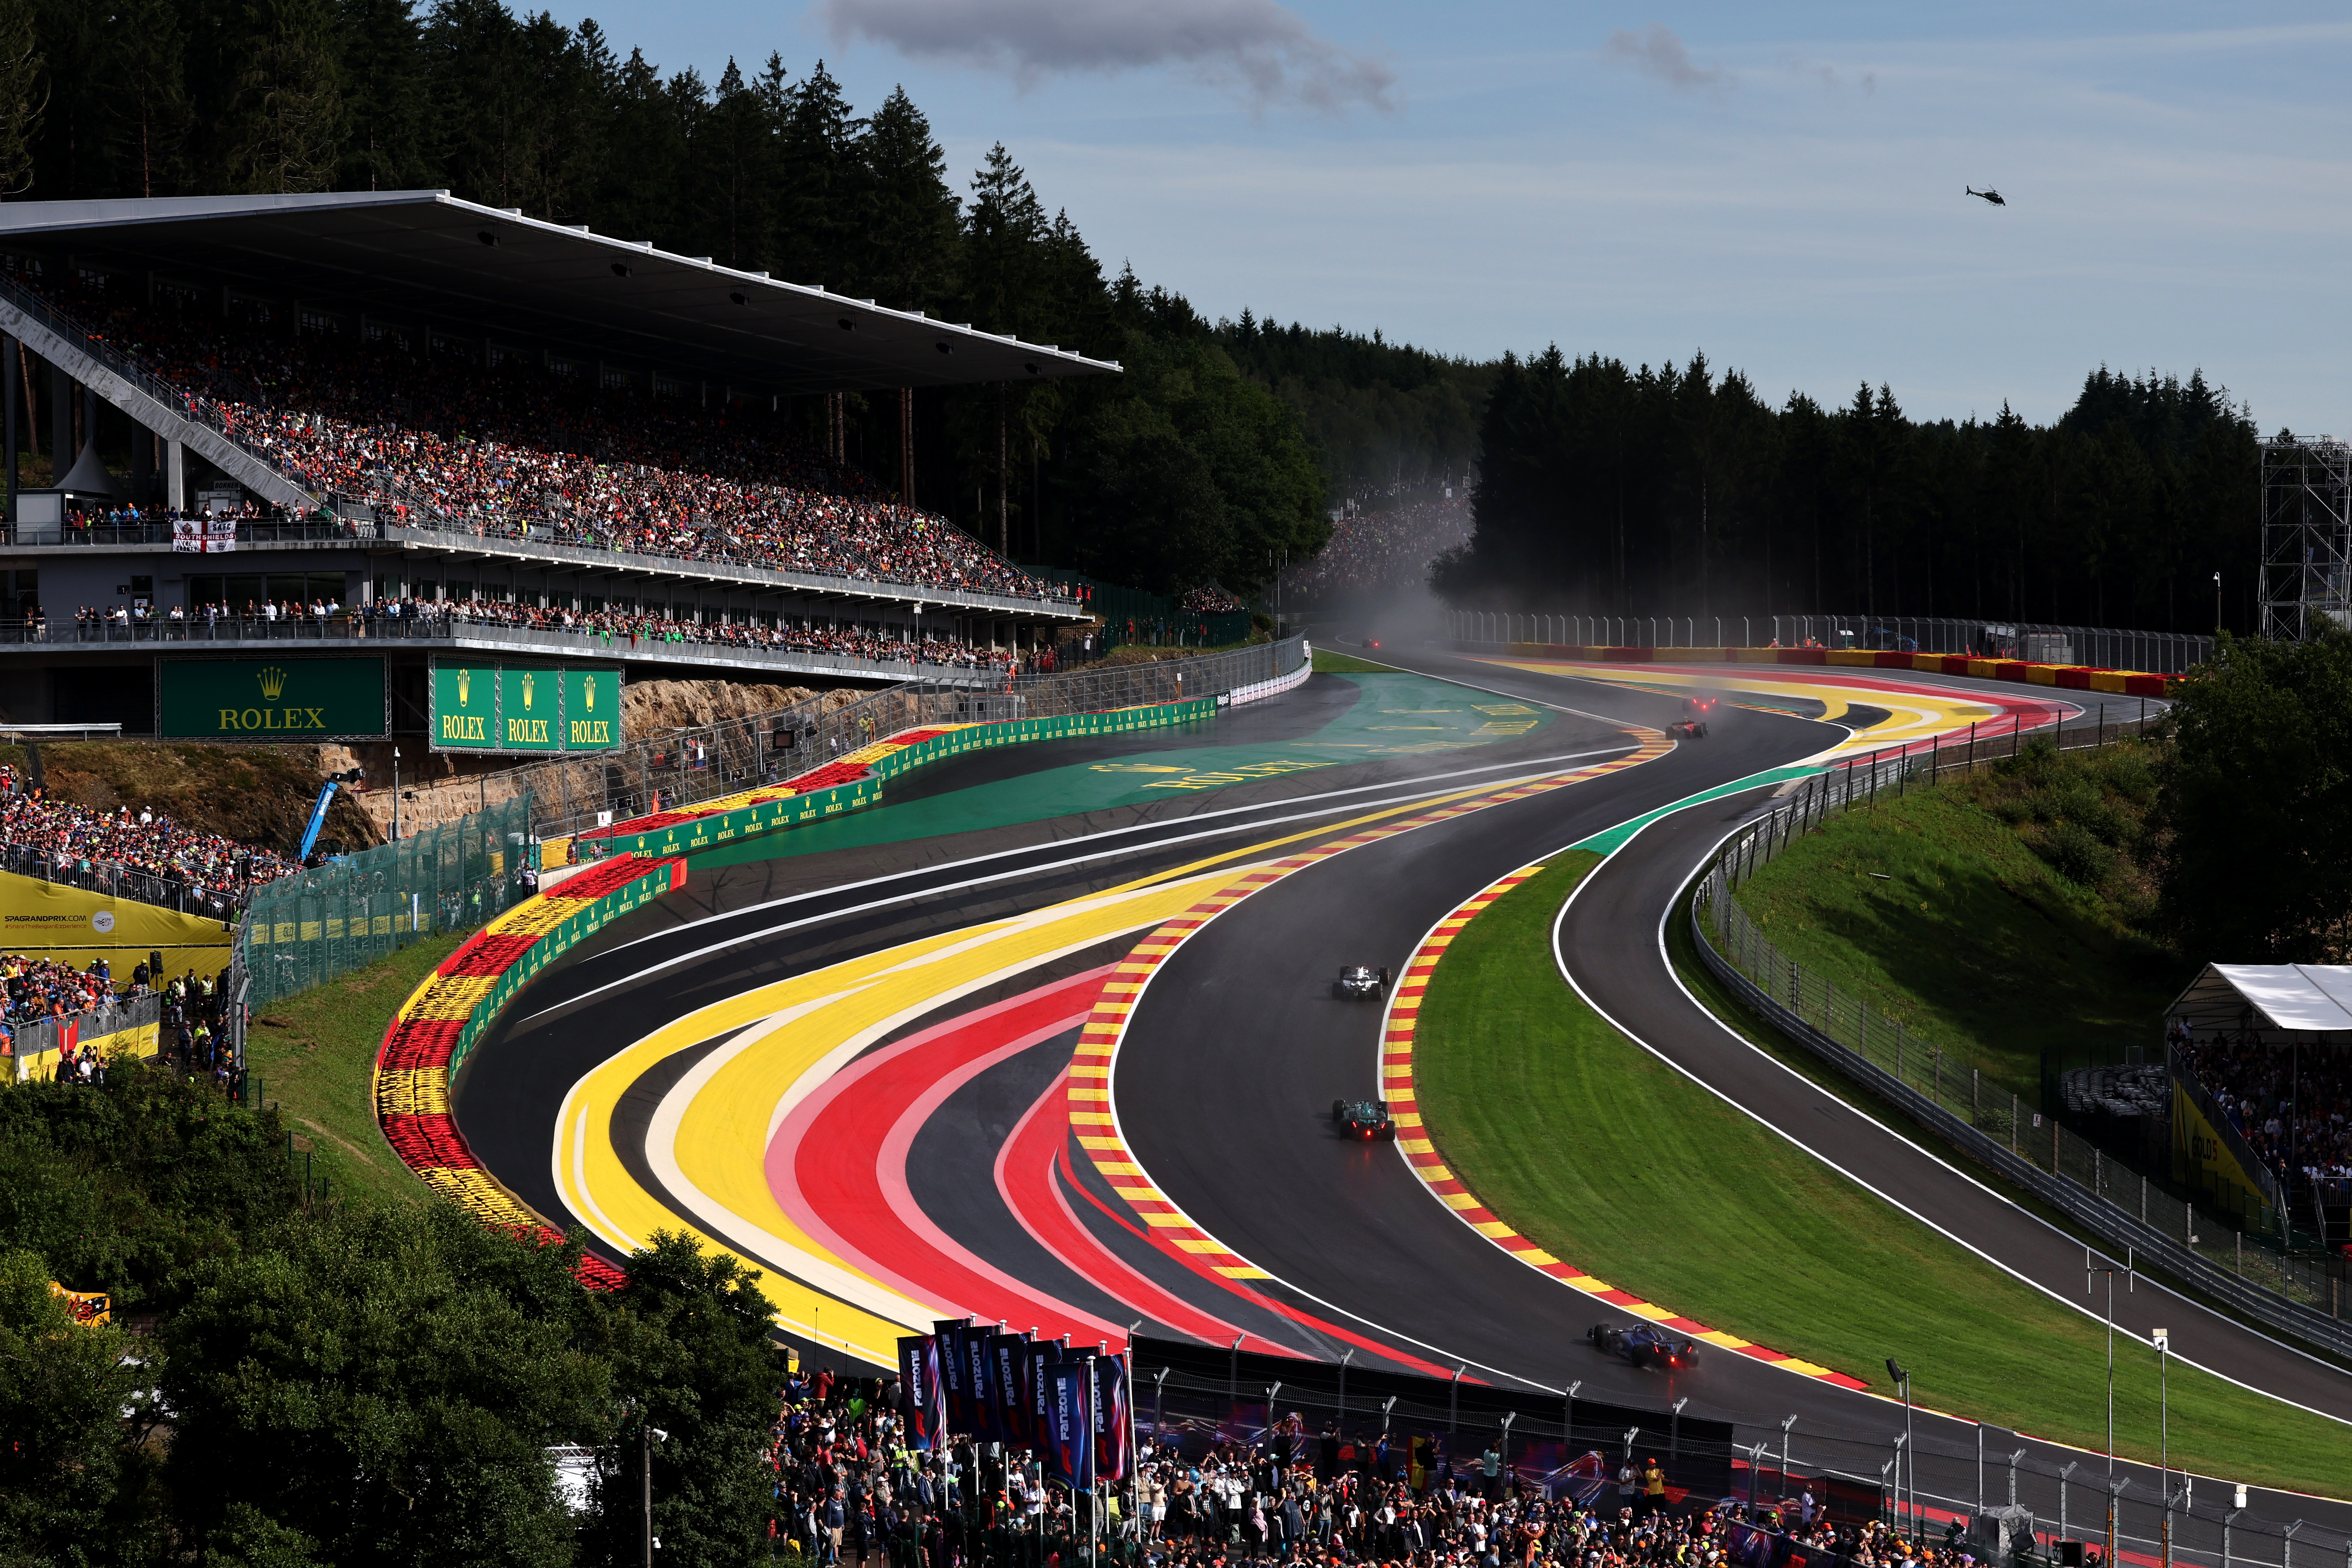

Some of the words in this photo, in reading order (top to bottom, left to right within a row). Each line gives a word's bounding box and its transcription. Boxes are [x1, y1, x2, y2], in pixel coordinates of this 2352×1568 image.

[218, 708, 326, 729] ROLEX
[443, 715, 485, 740] ROLEX
[508, 719, 548, 742] ROLEX
[571, 720, 609, 743] ROLEX
[914, 757, 922, 765] ROLEX
[1141, 760, 1339, 789] ROLEX
[852, 797, 866, 807] ROLEX
[873, 791, 882, 801] ROLE
[800, 809, 816, 820] ROLEX
[826, 803, 842, 813] ROLEX
[771, 815, 789, 826] ROLEX
[745, 822, 762, 833] ROLEX
[718, 829, 734, 840] ROLEX
[691, 836, 708, 847] ROLEX
[663, 843, 680, 854] ROLEX
[655, 882, 666, 894] ROLEX
[639, 891, 651, 904] ROLEX
[619, 900, 633, 913] ROLEX
[603, 910, 614, 923] ROLEX
[587, 920, 599, 933] ROLEX
[571, 931, 580, 944] ROLEX
[556, 941, 566, 954] ROLEX
[543, 951, 552, 965] ROLEX
[530, 962, 538, 976] ROLEX
[2192, 1135, 2211, 1160] GOLD
[2212, 1140, 2217, 1161] 5
